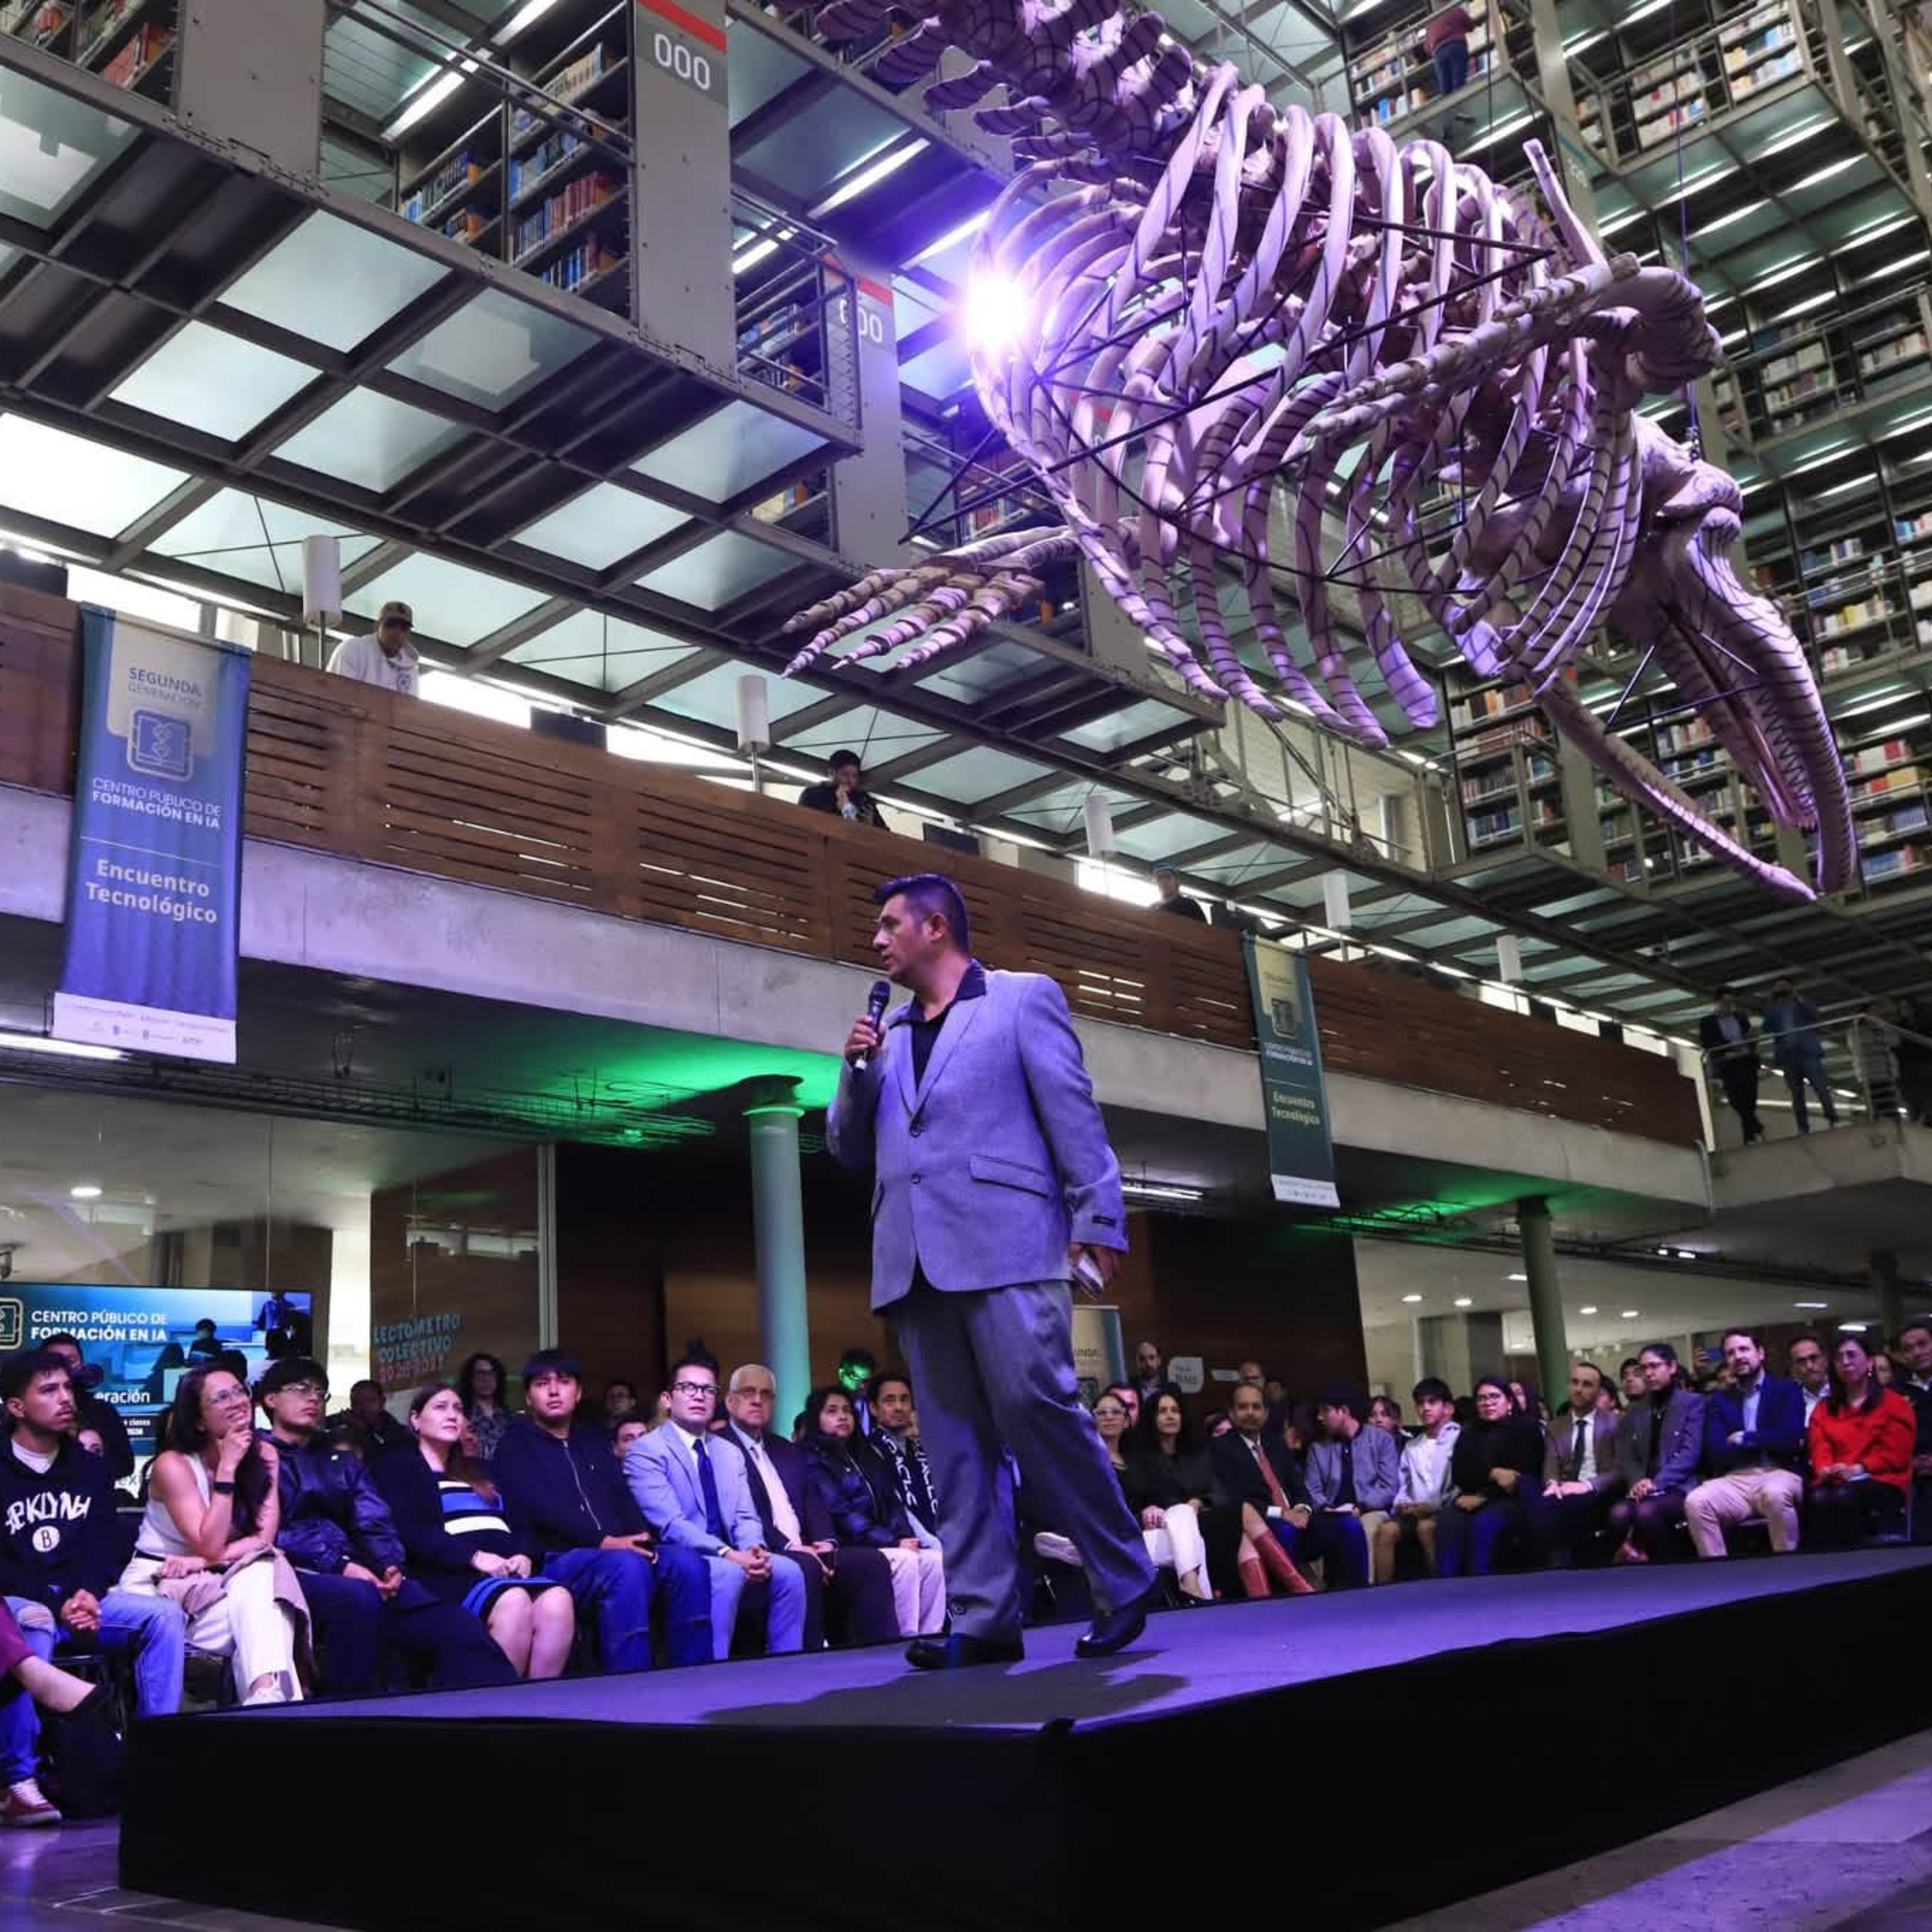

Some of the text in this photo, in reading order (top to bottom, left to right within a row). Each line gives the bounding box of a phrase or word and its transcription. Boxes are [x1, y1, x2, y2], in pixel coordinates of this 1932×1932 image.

[655, 33, 710, 90] 000
[129, 667, 202, 697] SEGUNDA
[93, 777, 222, 817] CENTRO PÚBLICO DE
[93, 791, 220, 828] FORMACIÓN EN IA
[97, 859, 209, 897] Encuentro
[84, 882, 217, 923] Tecnológico
[32, 1309, 167, 1325] CENTRO PÚBLICO DE
[129, 1328, 146, 1341] EN
[152, 1328, 167, 1341] IA
[93, 1388, 150, 1403] eración
[41, 1529, 52, 1549] B
